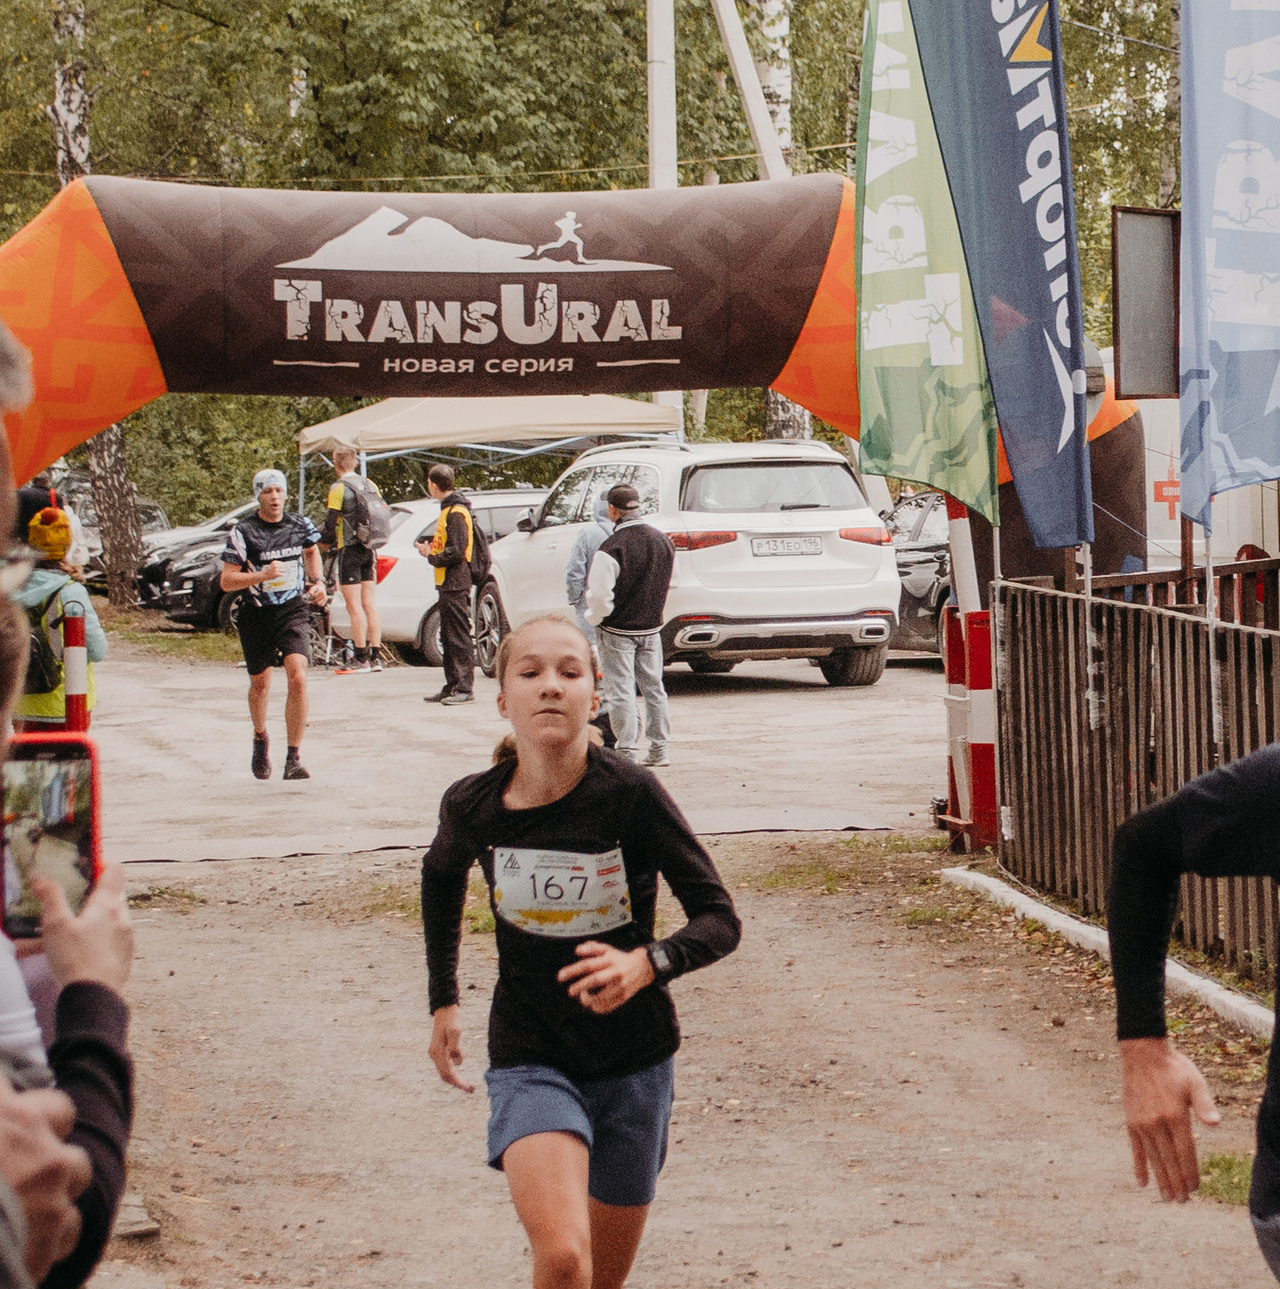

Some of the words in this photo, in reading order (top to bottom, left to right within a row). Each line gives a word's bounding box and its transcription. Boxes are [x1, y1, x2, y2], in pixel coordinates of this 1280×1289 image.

[383, 357, 474, 374] новая
[485, 357, 575, 378] серия
[529, 873, 588, 900] 167
